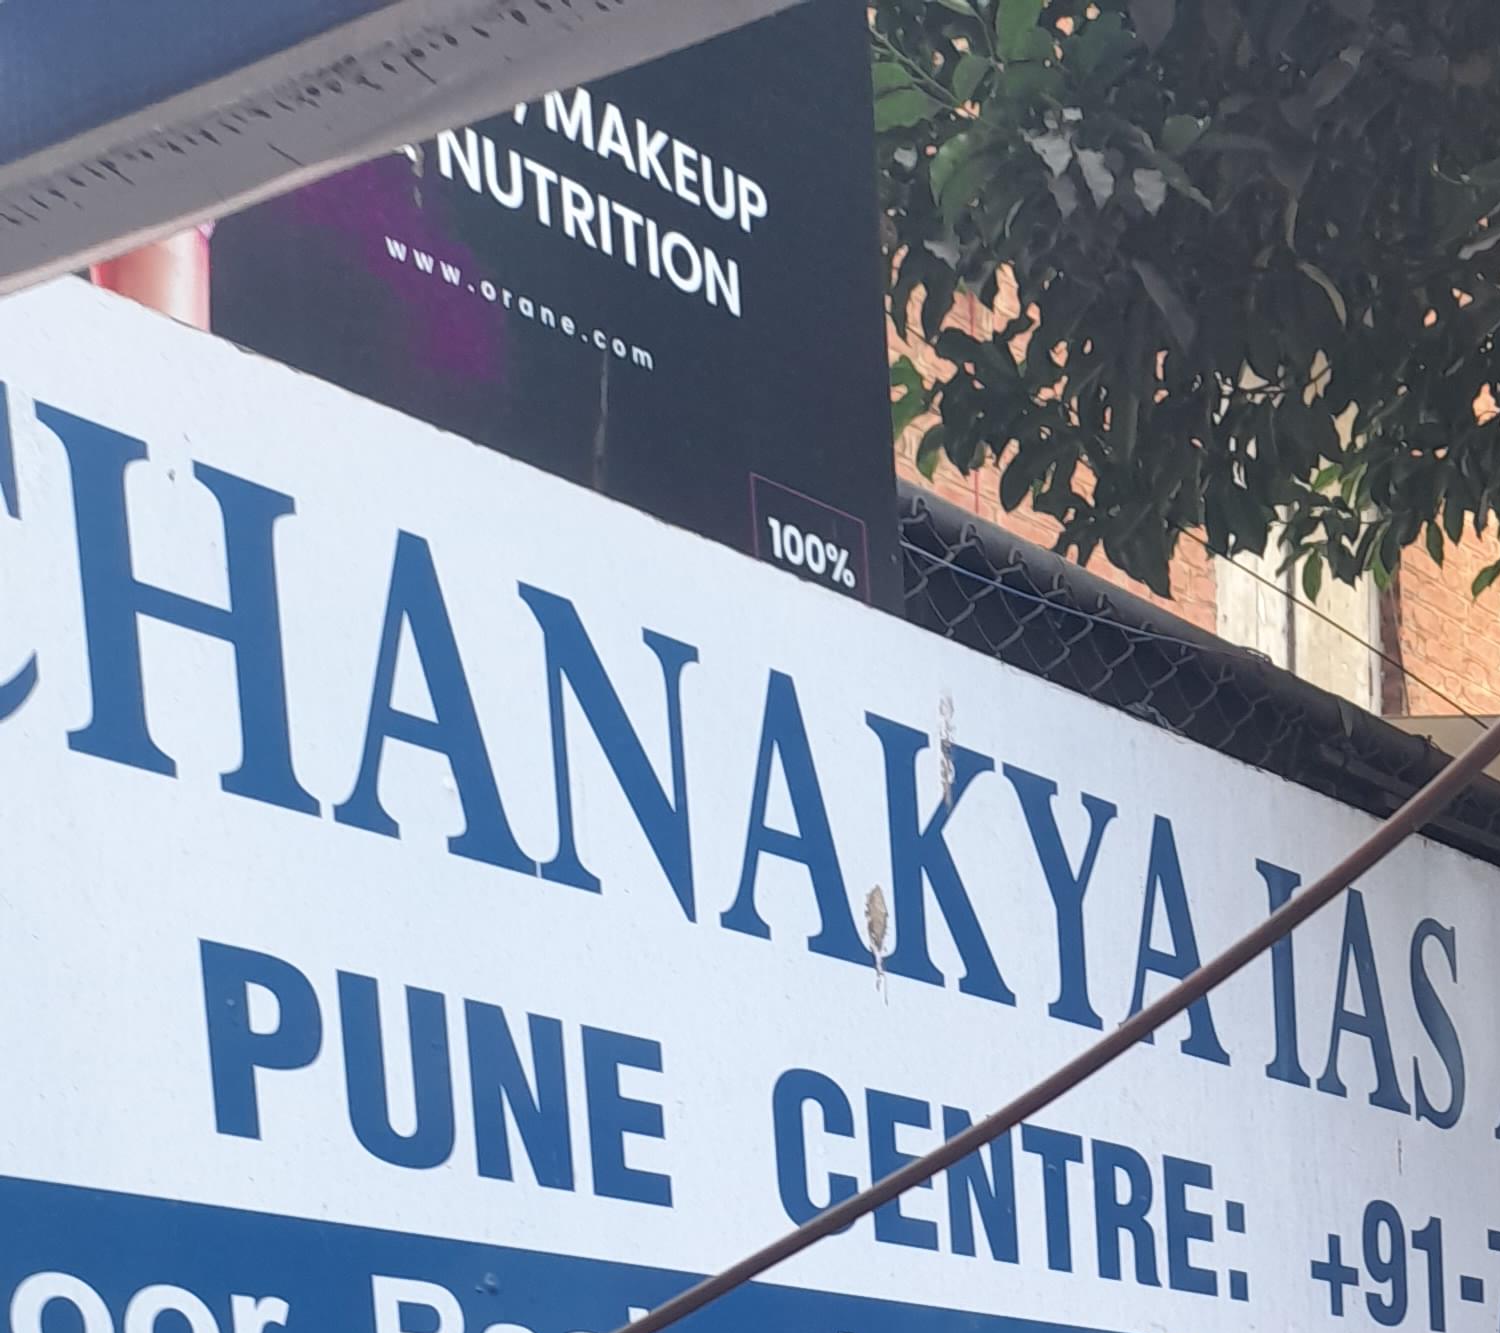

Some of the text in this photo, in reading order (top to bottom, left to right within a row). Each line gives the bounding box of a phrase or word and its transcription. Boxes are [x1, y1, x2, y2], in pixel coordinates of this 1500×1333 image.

[437, 126, 742, 319] NUTRITION
[543, 85, 769, 233] MAKEUP
[384, 235, 654, 371] www.orane.com
[767, 516, 856, 588] 100%
[1255, 858, 1465, 1130] IAS
[199, 938, 674, 1208] PUNE
[772, 1068, 1249, 1302] CENTRE:
